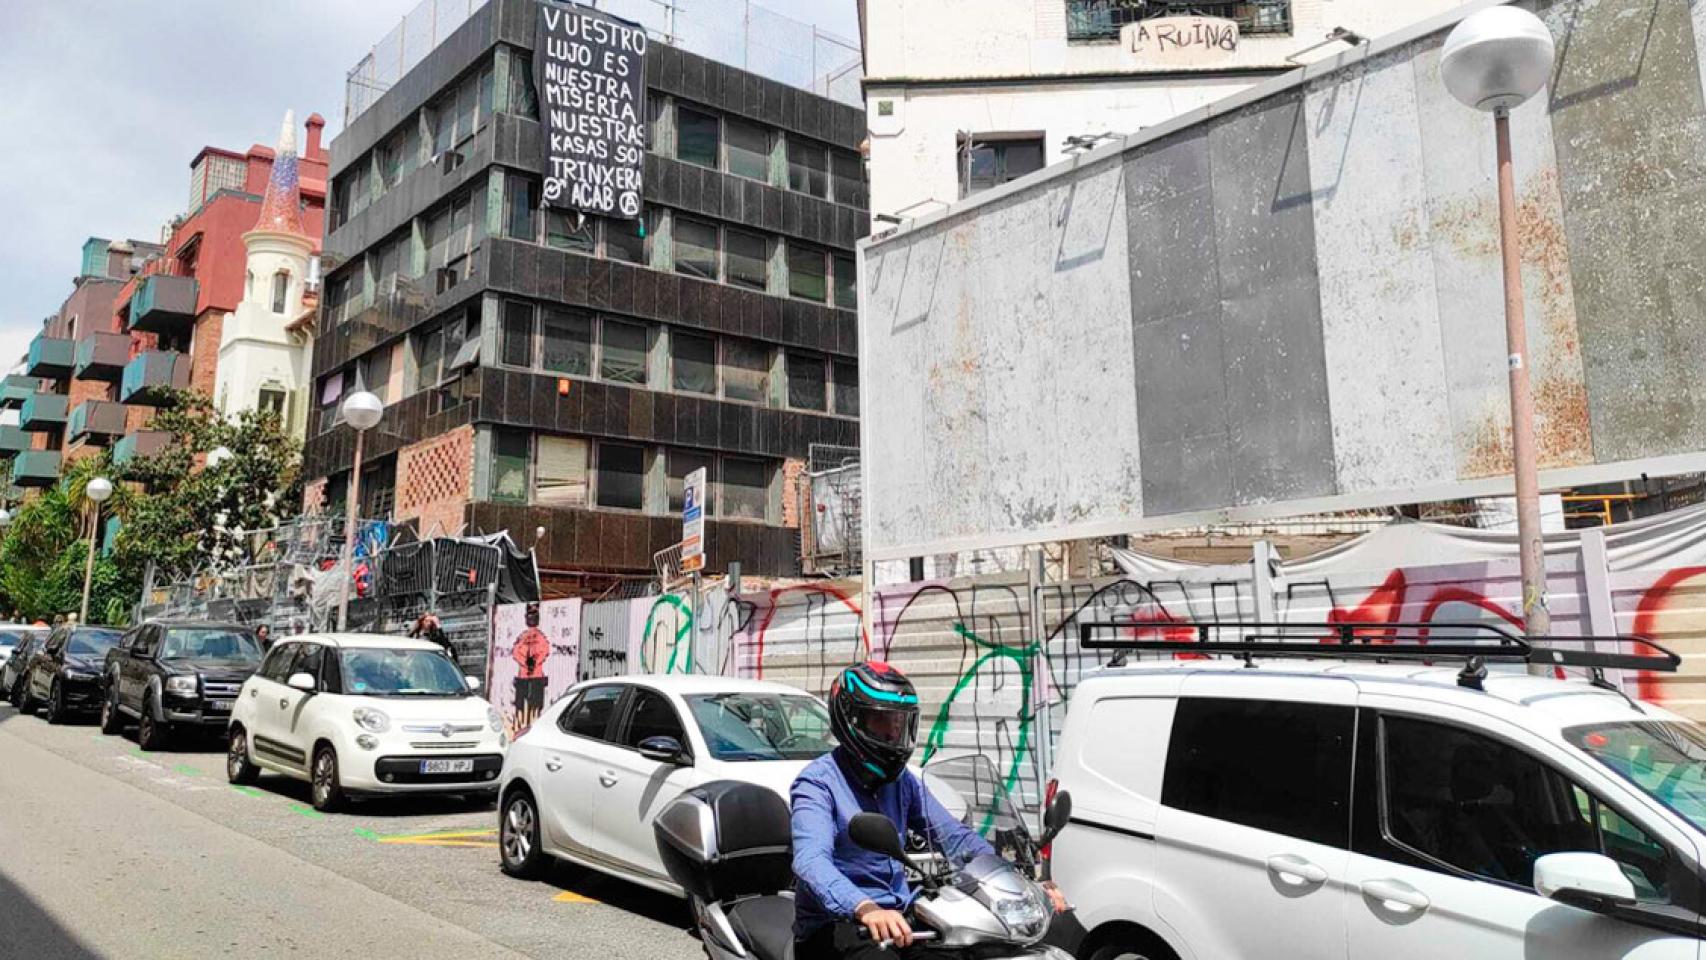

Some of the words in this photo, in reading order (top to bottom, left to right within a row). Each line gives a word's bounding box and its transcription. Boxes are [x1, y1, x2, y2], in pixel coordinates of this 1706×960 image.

[543, 7, 646, 55] VUESTRO
[1131, 23, 1150, 54] LA
[547, 37, 591, 66] LUJO
[604, 52, 629, 76] ES
[545, 63, 633, 100] NUESTRA
[546, 84, 637, 123] MISERIA
[550, 109, 644, 146] NUESTRAS
[550, 133, 608, 162] KASAS
[571, 182, 614, 211] ACAB
